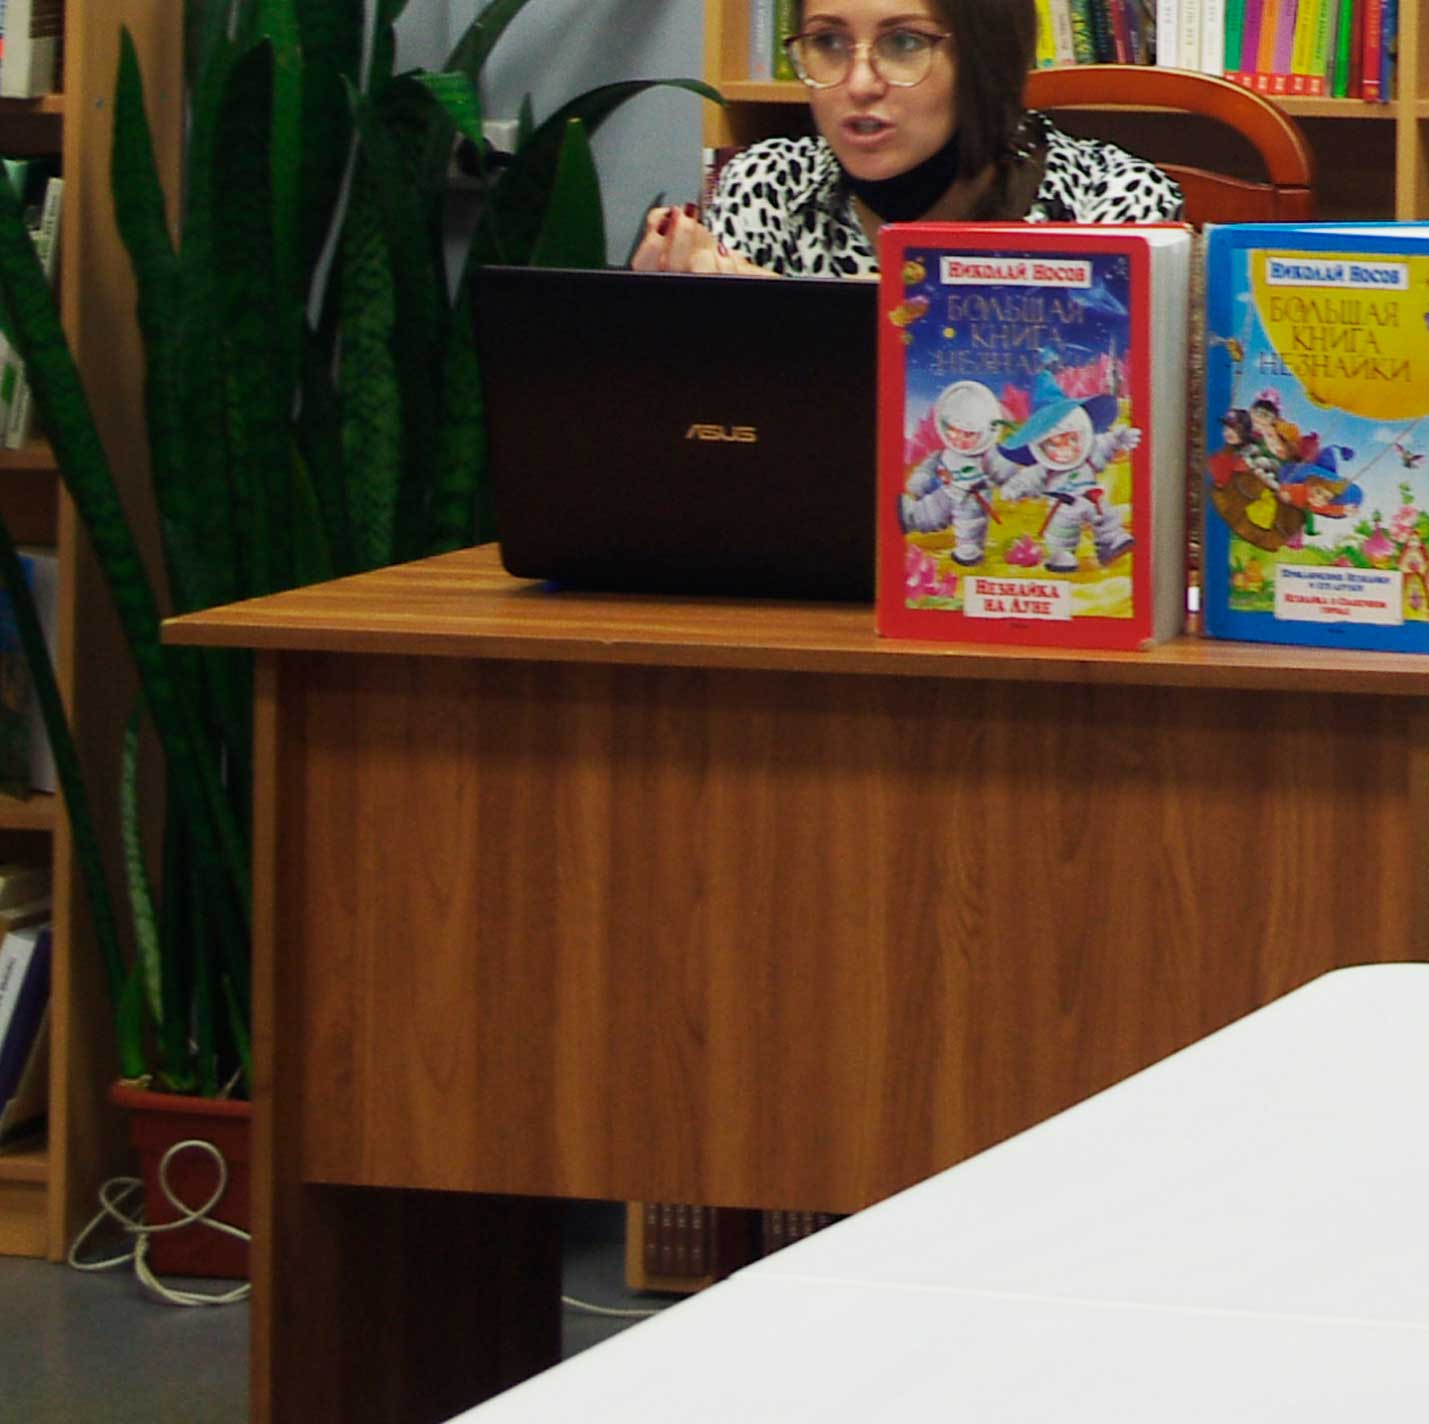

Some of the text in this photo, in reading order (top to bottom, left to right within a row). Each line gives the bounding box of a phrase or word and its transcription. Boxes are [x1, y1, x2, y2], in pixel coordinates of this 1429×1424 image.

[947, 293, 1085, 324] БОЛЬШАЯ
[1269, 295, 1400, 327] БОЛЬШАЯ
[971, 323, 1068, 352] КНИГА
[1292, 325, 1382, 354] КНИГА
[1259, 351, 1412, 383] НЕЗНАЙКИ
[685, 424, 757, 443] ASUS
